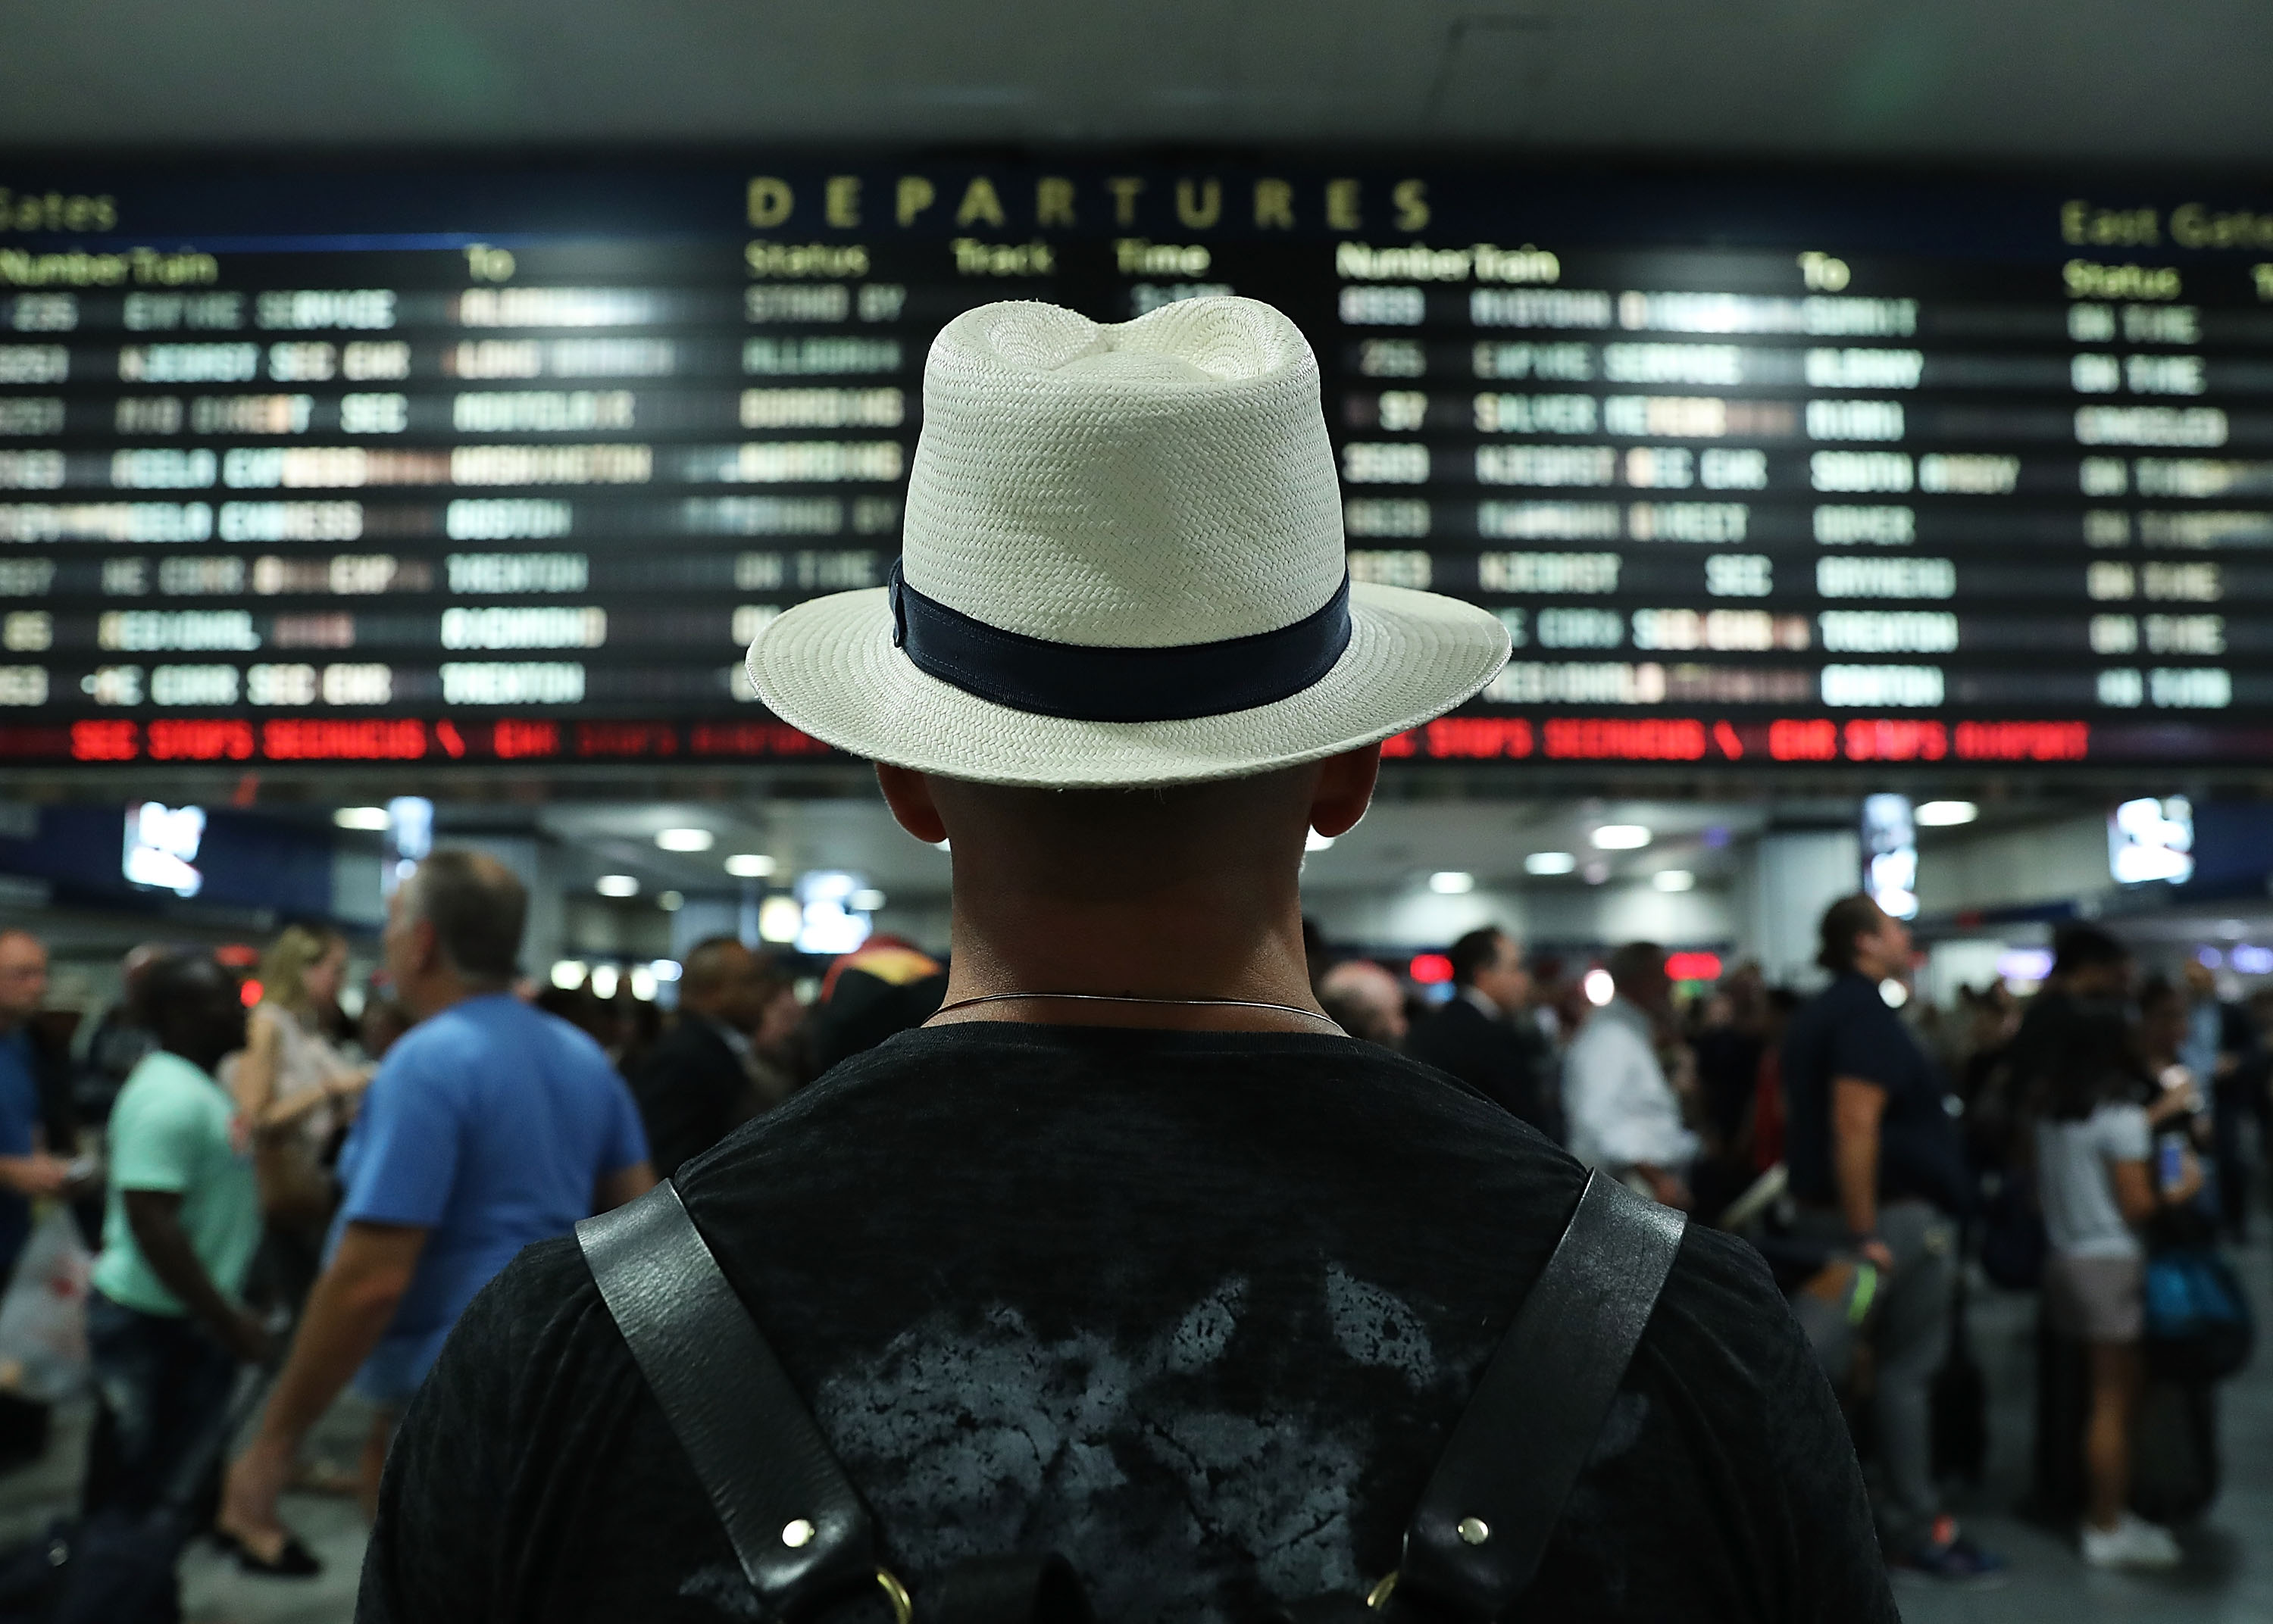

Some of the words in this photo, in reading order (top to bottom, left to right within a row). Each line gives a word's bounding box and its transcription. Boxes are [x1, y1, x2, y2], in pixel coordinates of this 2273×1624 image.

[747, 176, 1430, 229] DEPARTURES
[464, 244, 515, 281] To
[746, 240, 868, 276] Status
[952, 238, 1055, 275] Track
[1113, 237, 1210, 276] Time
[1337, 242, 1469, 281] Number
[1472, 244, 1559, 284] Train
[1797, 252, 1849, 292] To
[2062, 260, 2181, 298] Status
